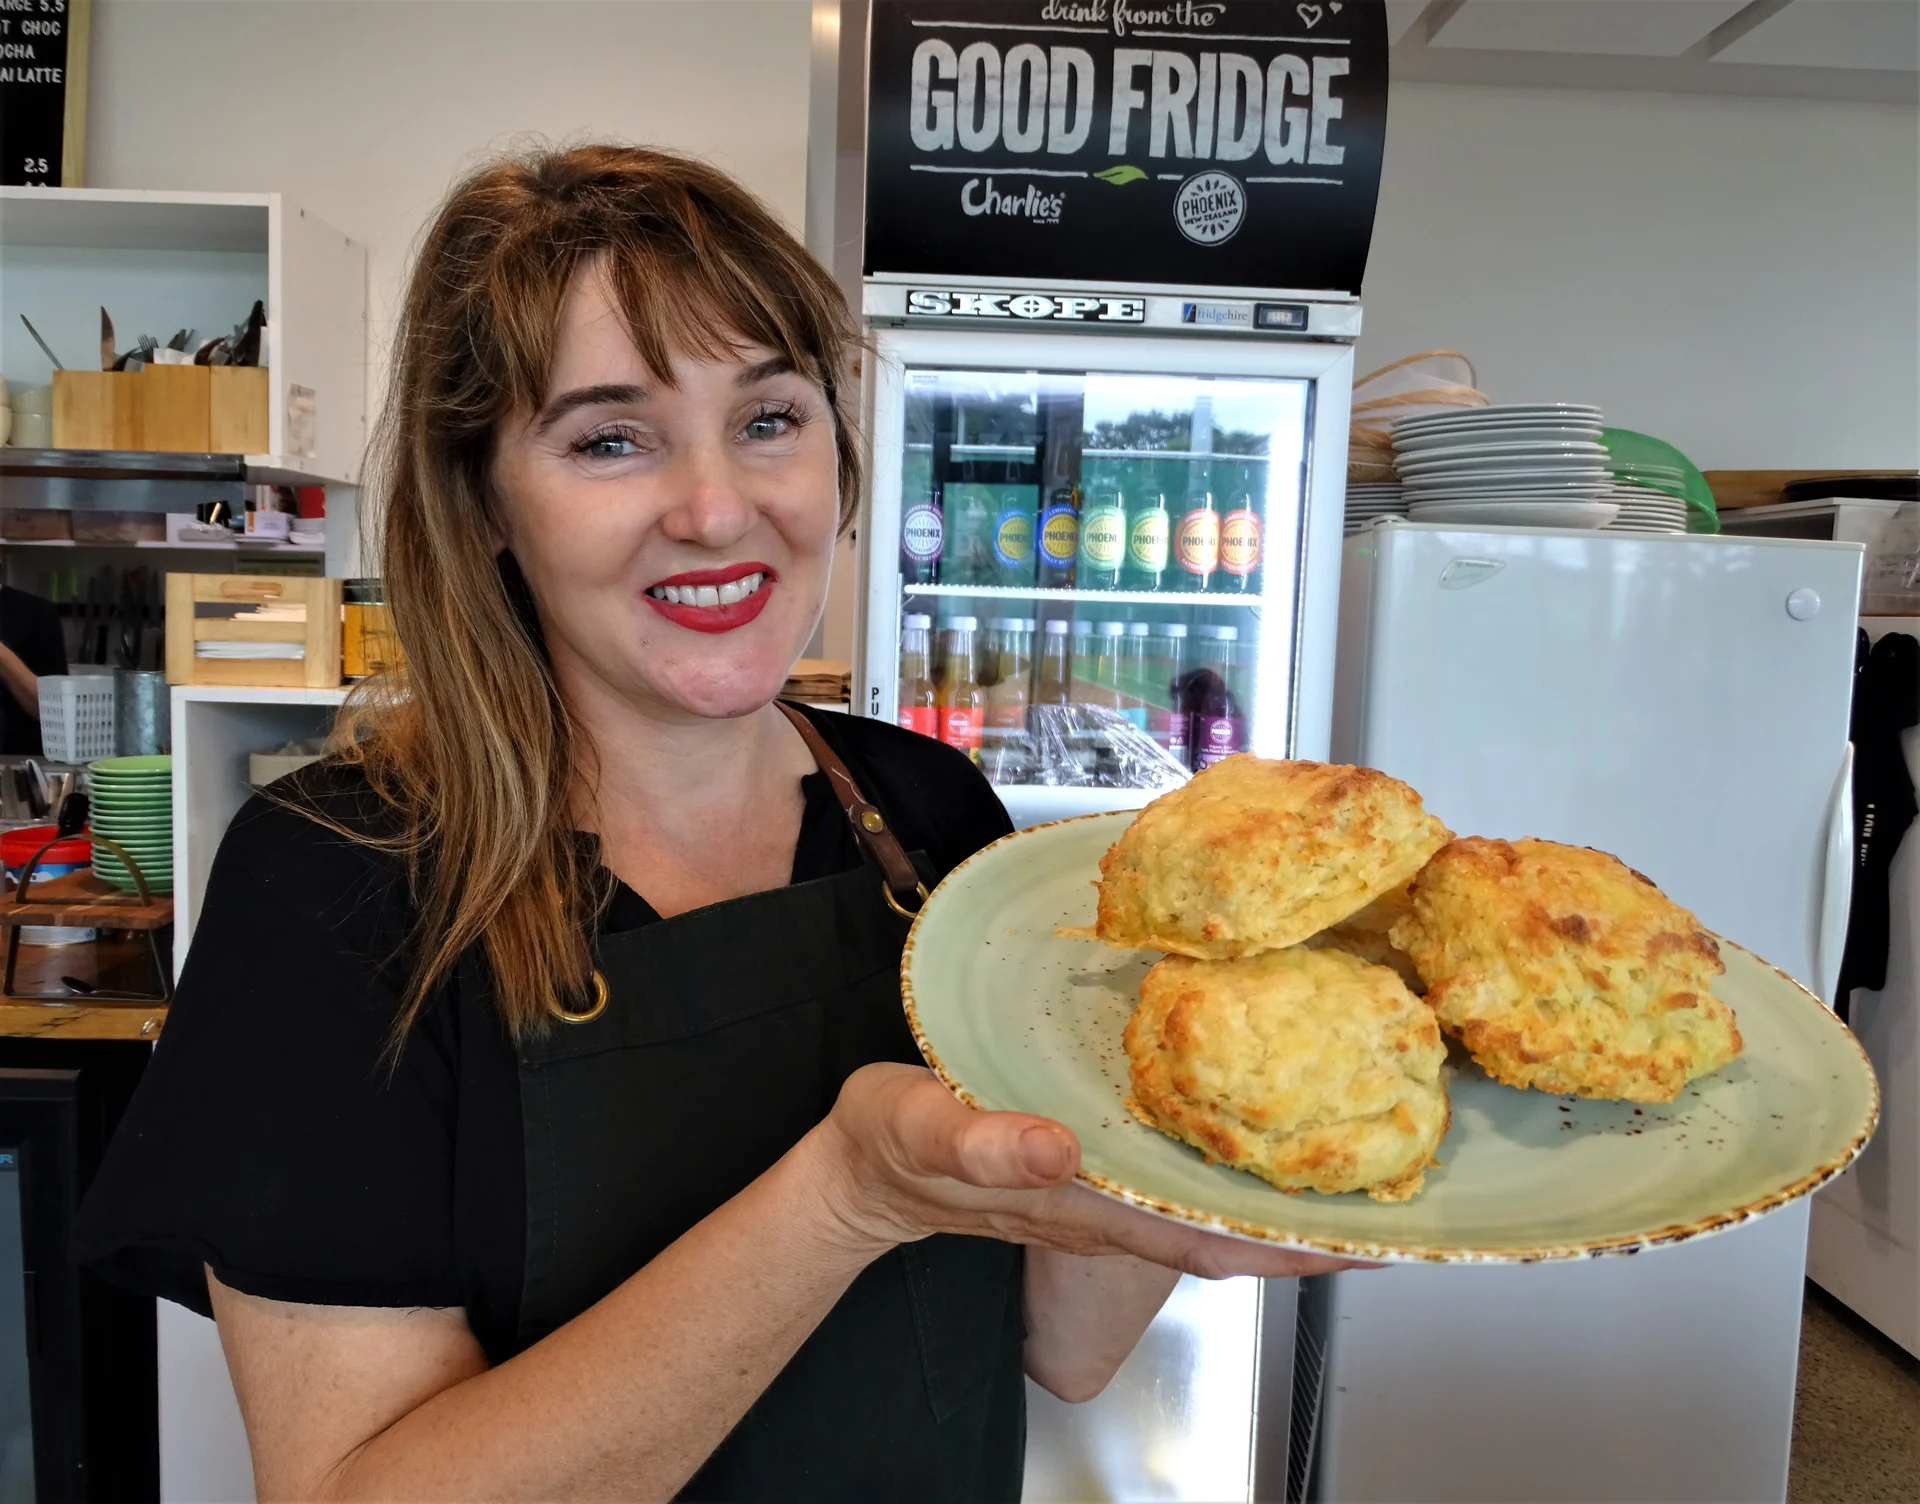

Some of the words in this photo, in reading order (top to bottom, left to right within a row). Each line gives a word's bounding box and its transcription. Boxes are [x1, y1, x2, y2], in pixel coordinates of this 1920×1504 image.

[22, 20, 61, 36] CHOC
[1041, 0, 1108, 22] drink
[1113, 0, 1172, 37] from
[1167, 0, 1226, 27] the
[17, 67, 63, 83] LATTE
[910, 39, 1095, 154] GOOD
[1108, 48, 1350, 165] FRIDGE
[24, 157, 49, 173] 2.5
[961, 177, 1063, 218] Charlie's
[1182, 189, 1237, 218] PHOENIX
[1184, 216, 1201, 226] NEW
[1204, 208, 1238, 221] ZEALAND
[909, 291, 1144, 321] SKOPE
[905, 527, 940, 539] PHOENIX
[1086, 532, 1117, 543] PHOENI
[871, 686, 879, 719] PU
